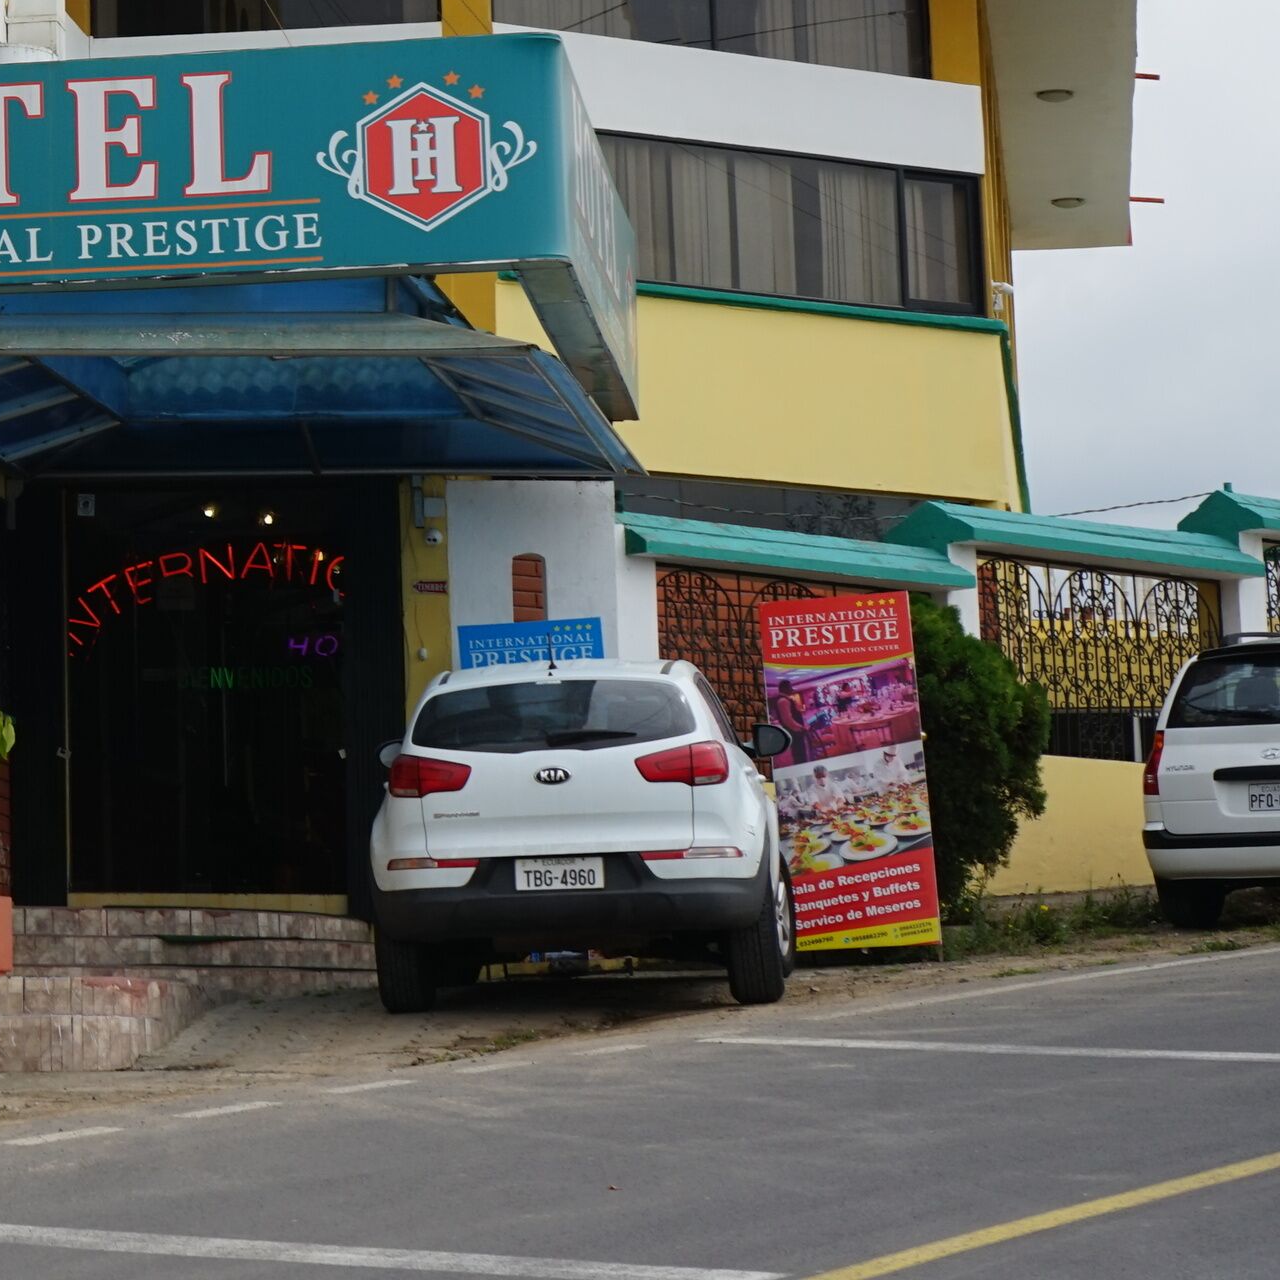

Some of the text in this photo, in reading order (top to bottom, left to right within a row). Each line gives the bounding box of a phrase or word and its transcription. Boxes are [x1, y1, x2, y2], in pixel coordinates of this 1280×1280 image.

[77, 211, 323, 261] PRESTIGE
[68, 540, 346, 657] NTERNATI
[768, 608, 897, 626] INTERNATIONAL
[469, 632, 593, 649] INTERNATIONAL
[769, 620, 899, 649] PRESTIGE
[812, 647, 866, 656] CONVENTION
[868, 644, 900, 652] CENTER
[539, 770, 566, 781] KIA
[1251, 793, 1280, 808] PFQ-
[524, 868, 596, 888] TBG-4960
[818, 879, 834, 890] de
[837, 863, 921, 886] Recepciones
[794, 881, 920, 913] Banquetes y Buffets
[795, 899, 921, 931] Servico de Meseros
